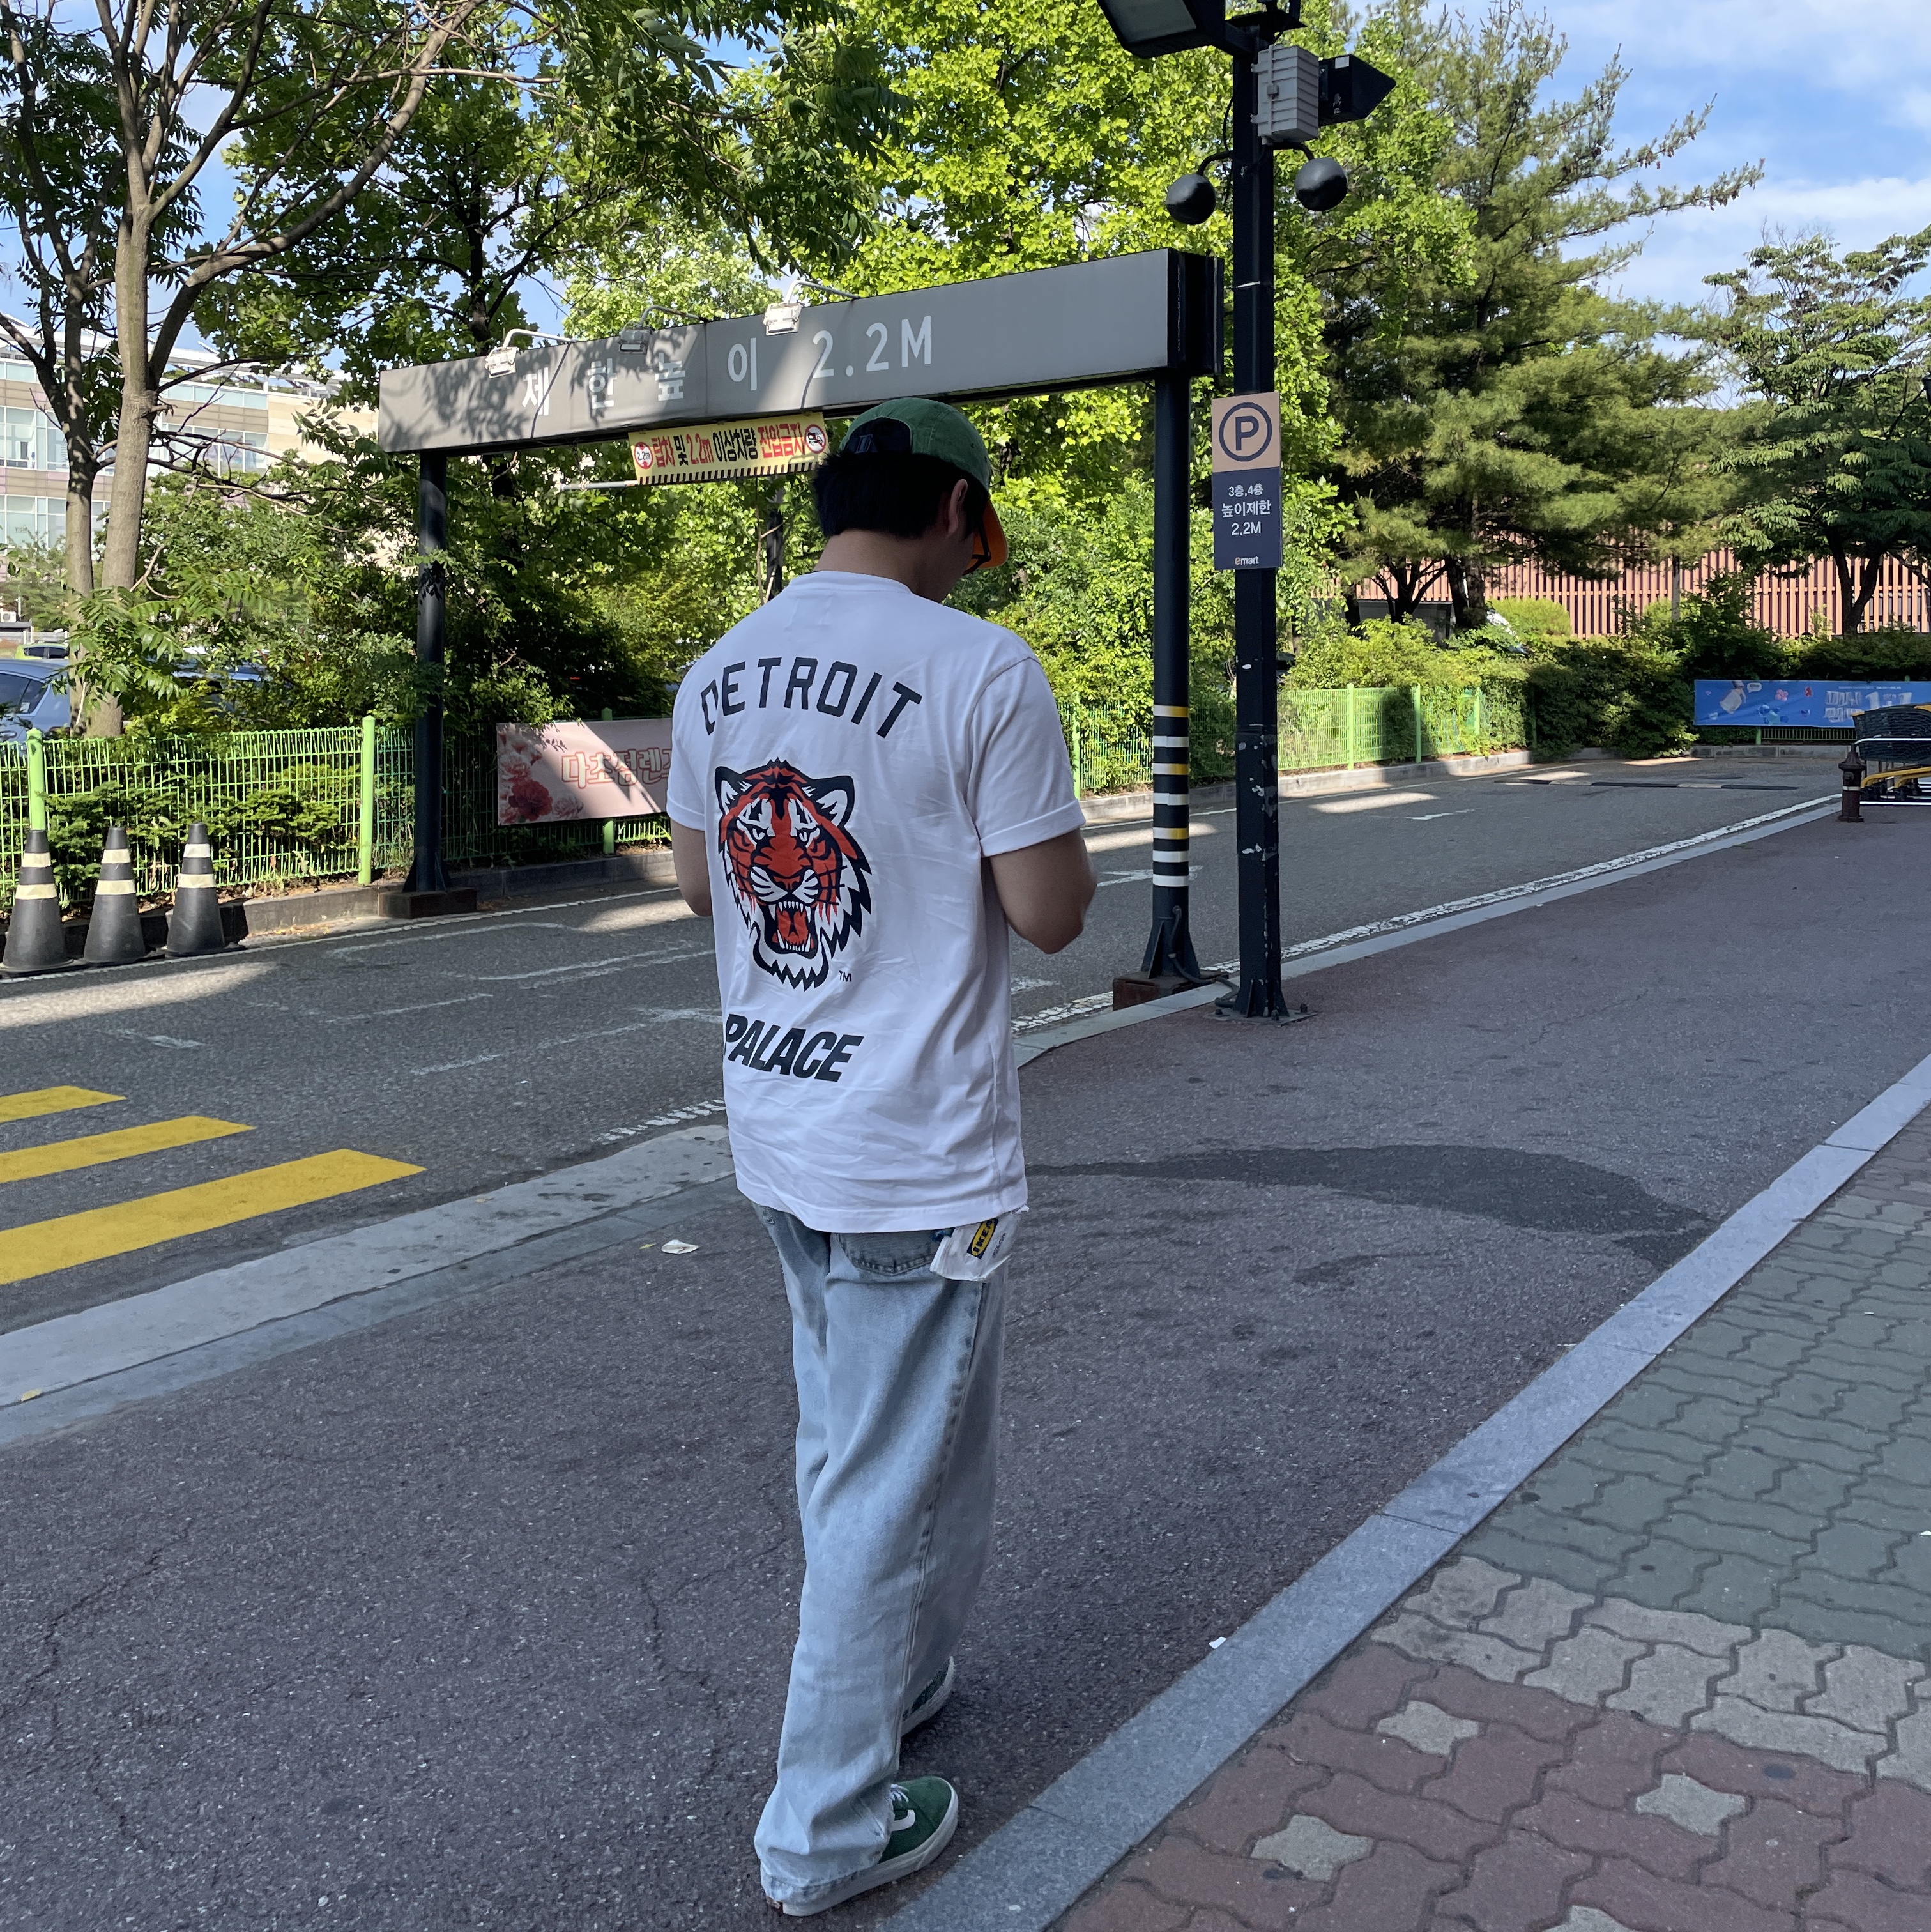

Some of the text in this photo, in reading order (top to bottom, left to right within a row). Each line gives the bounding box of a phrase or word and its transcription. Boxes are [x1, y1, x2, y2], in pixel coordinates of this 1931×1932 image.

[812, 315, 931, 379] 2.2M
[651, 422, 806, 468] 탑차 및 2.2m 이상차량 진입금지
[1235, 415, 1260, 452] P
[1221, 499, 1272, 518] 높이제한
[1231, 521, 1262, 536] 2.2M
[1234, 556, 1260, 566] emart
[700, 657, 923, 739] DETROIT
[838, 970, 853, 983] TM
[724, 1013, 865, 1083] PALACE
[973, 1218, 995, 1253] IKEA
